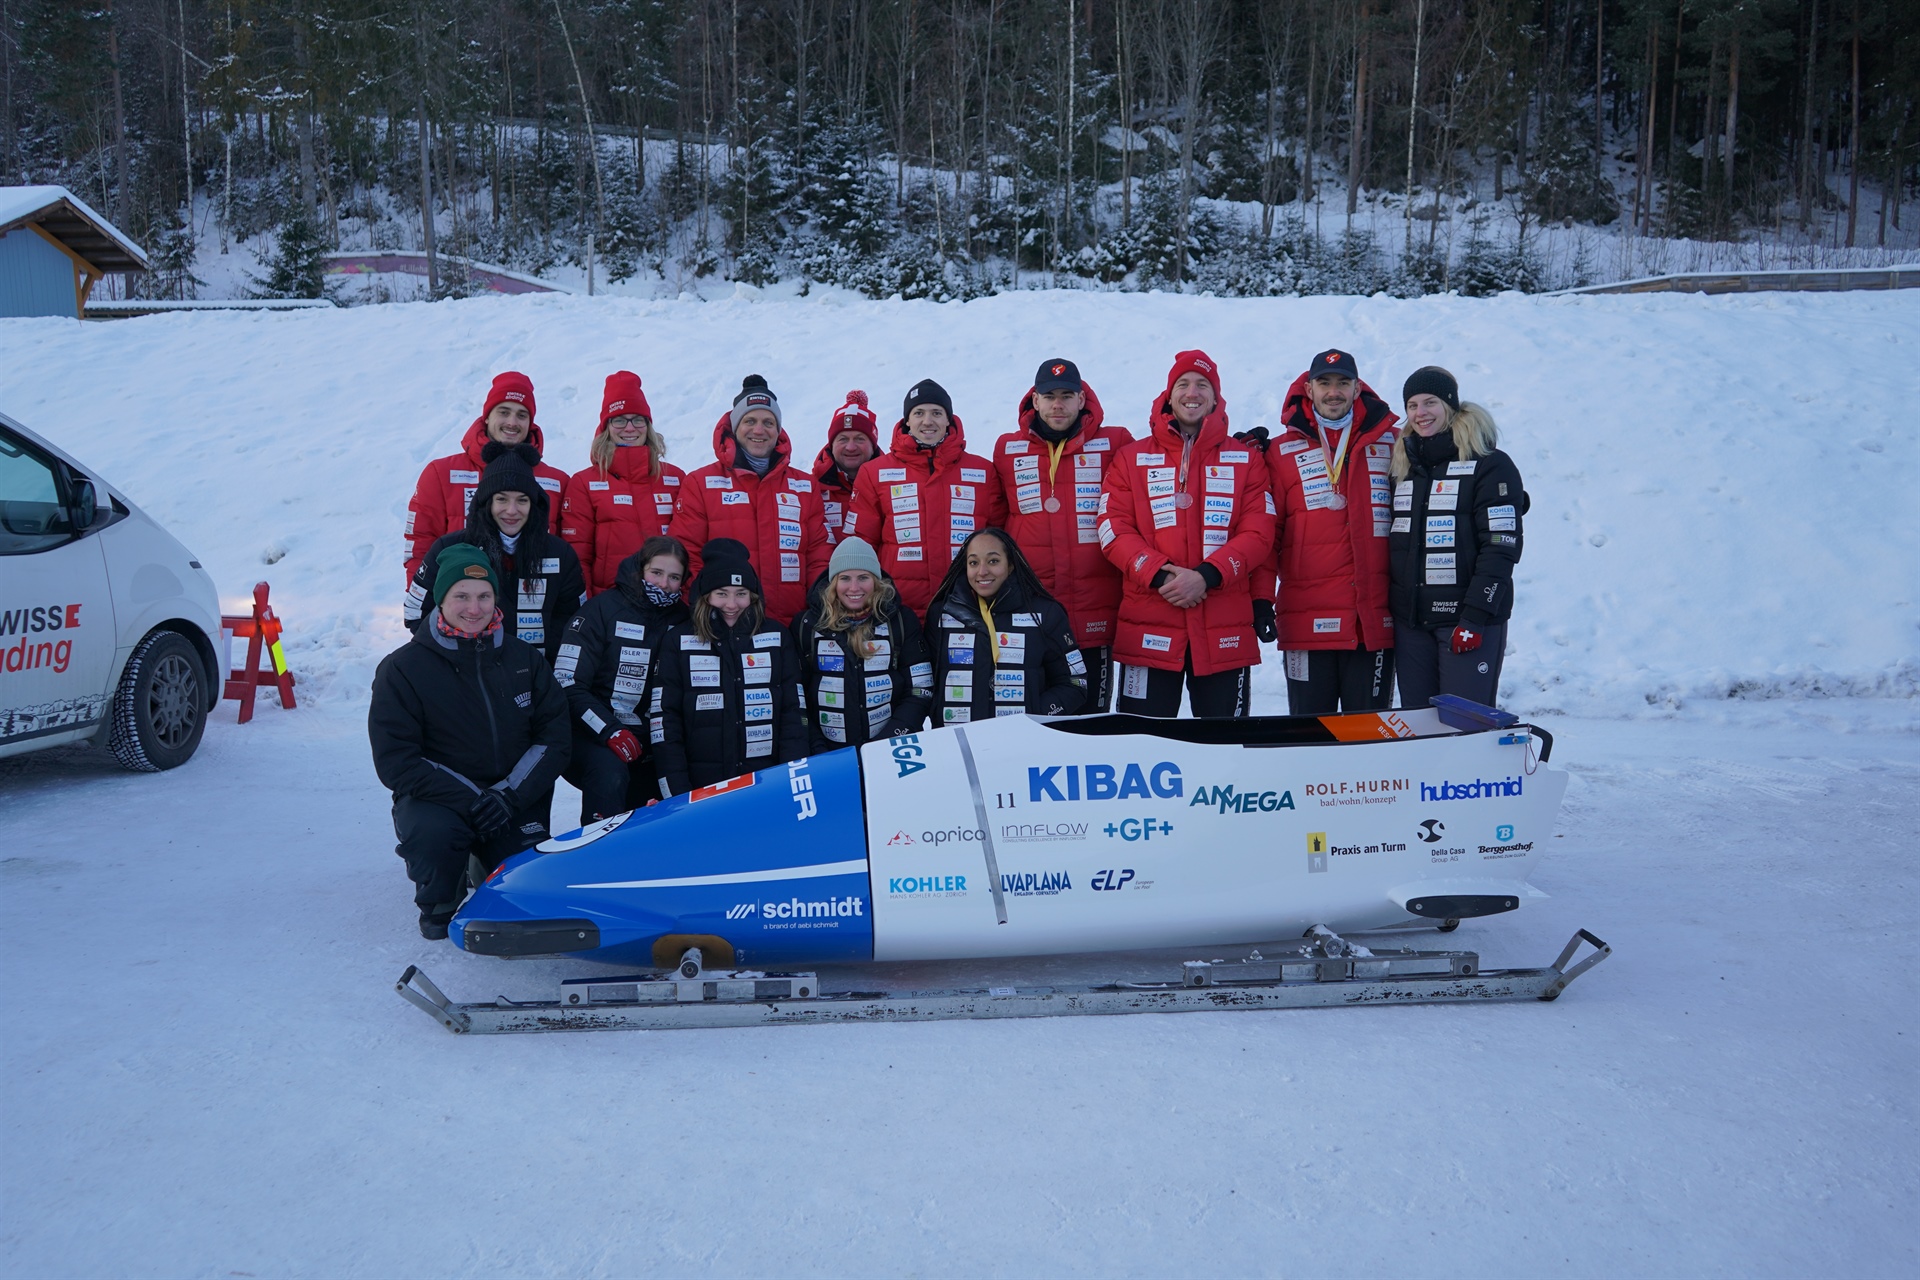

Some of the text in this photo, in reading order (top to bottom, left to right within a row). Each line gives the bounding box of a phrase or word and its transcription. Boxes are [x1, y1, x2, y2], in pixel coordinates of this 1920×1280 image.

[780, 524, 800, 532] KIBAG
[867, 678, 890, 688] KIBAG
[1098, 646, 1108, 708] STADLE
[746, 692, 770, 700] KIBAG
[1028, 762, 1184, 802] KIBAG
[1420, 776, 1522, 802] hubschmid
[996, 792, 1016, 809] 11
[1320, 796, 1396, 808] bad/wohn/konzept
[922, 826, 986, 846] aprica
[1104, 818, 1174, 842] +GF+
[1331, 842, 1406, 856] Praxis am Turm
[1432, 848, 1448, 856] Della
[1478, 842, 1533, 854] Berggasthof
[890, 876, 968, 894] KOHLER
[989, 870, 1072, 894] LVAPLANA
[763, 897, 863, 918] schmidt
